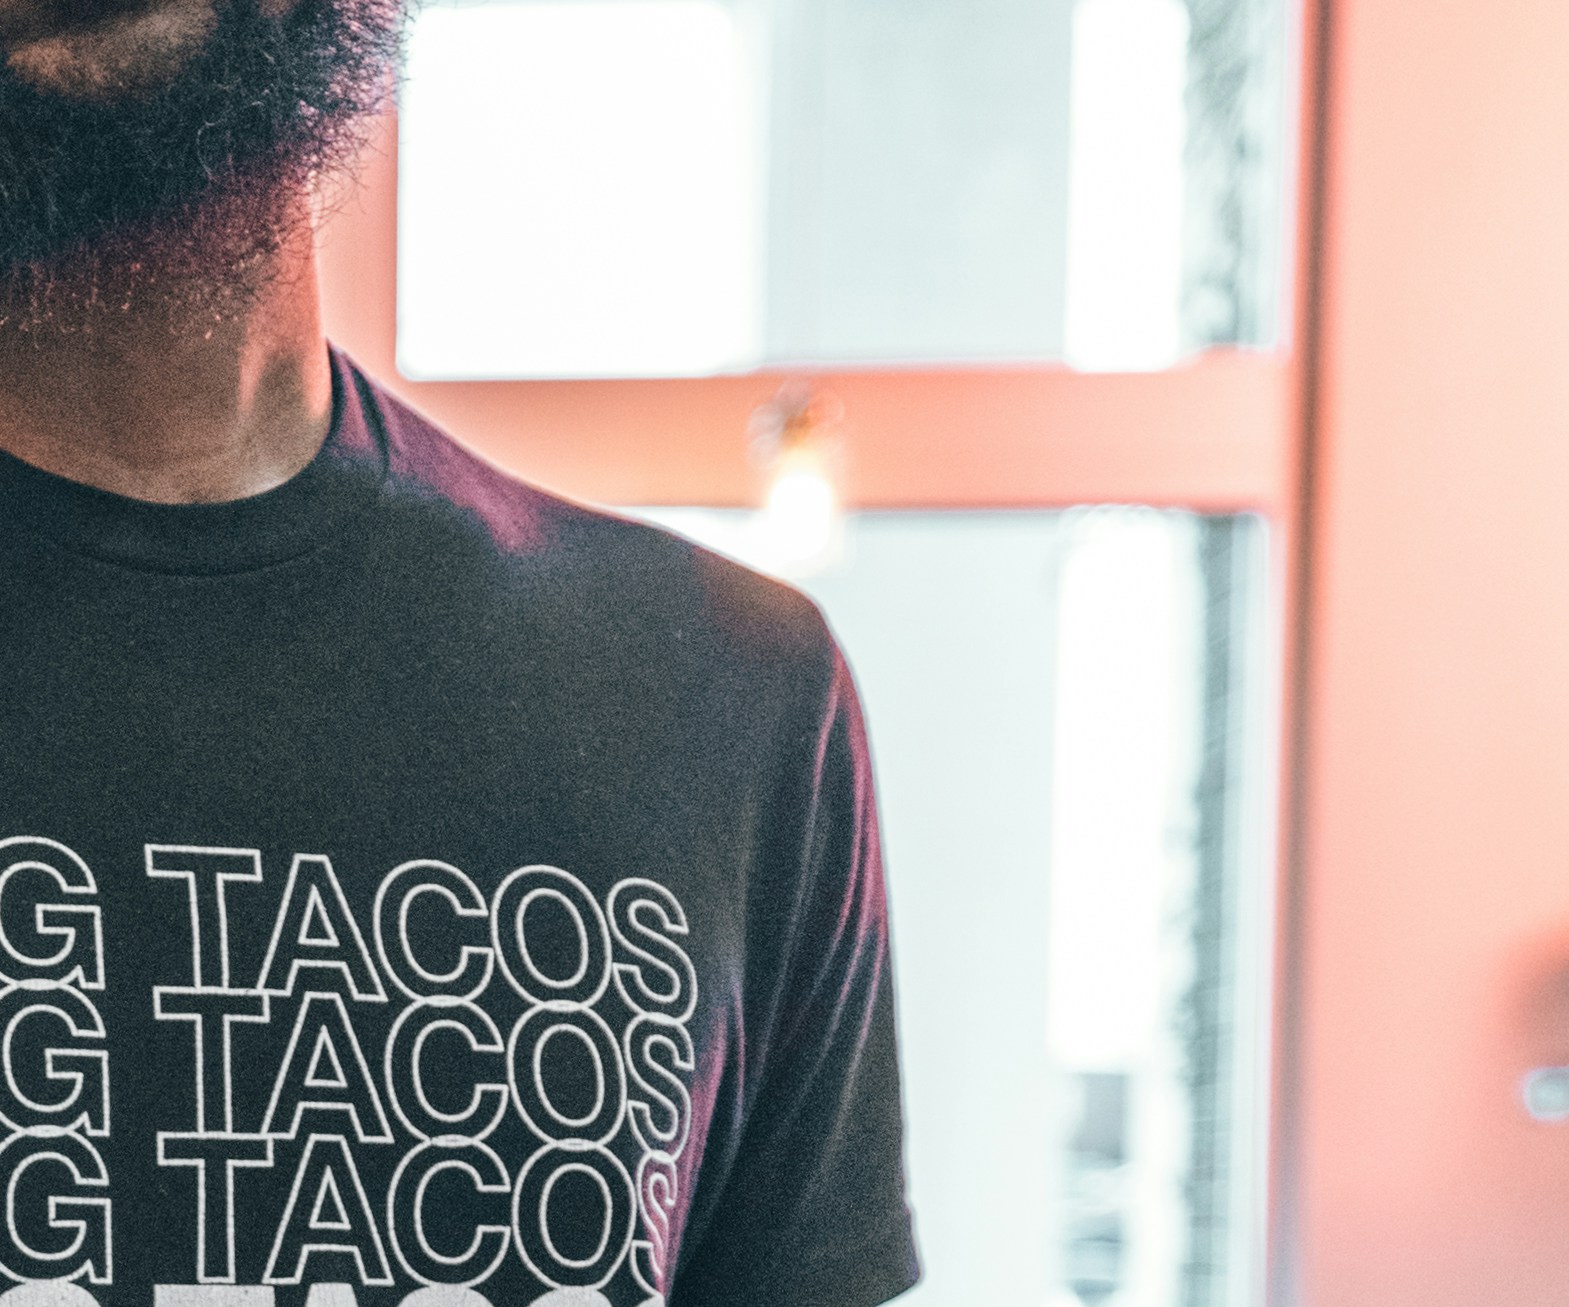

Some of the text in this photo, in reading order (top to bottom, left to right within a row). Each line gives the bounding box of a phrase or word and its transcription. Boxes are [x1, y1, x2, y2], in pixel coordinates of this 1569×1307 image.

[144, 843, 698, 1026] TACOS
[153, 985, 695, 1164] TACOS
[157, 1131, 678, 1296] TACOS
